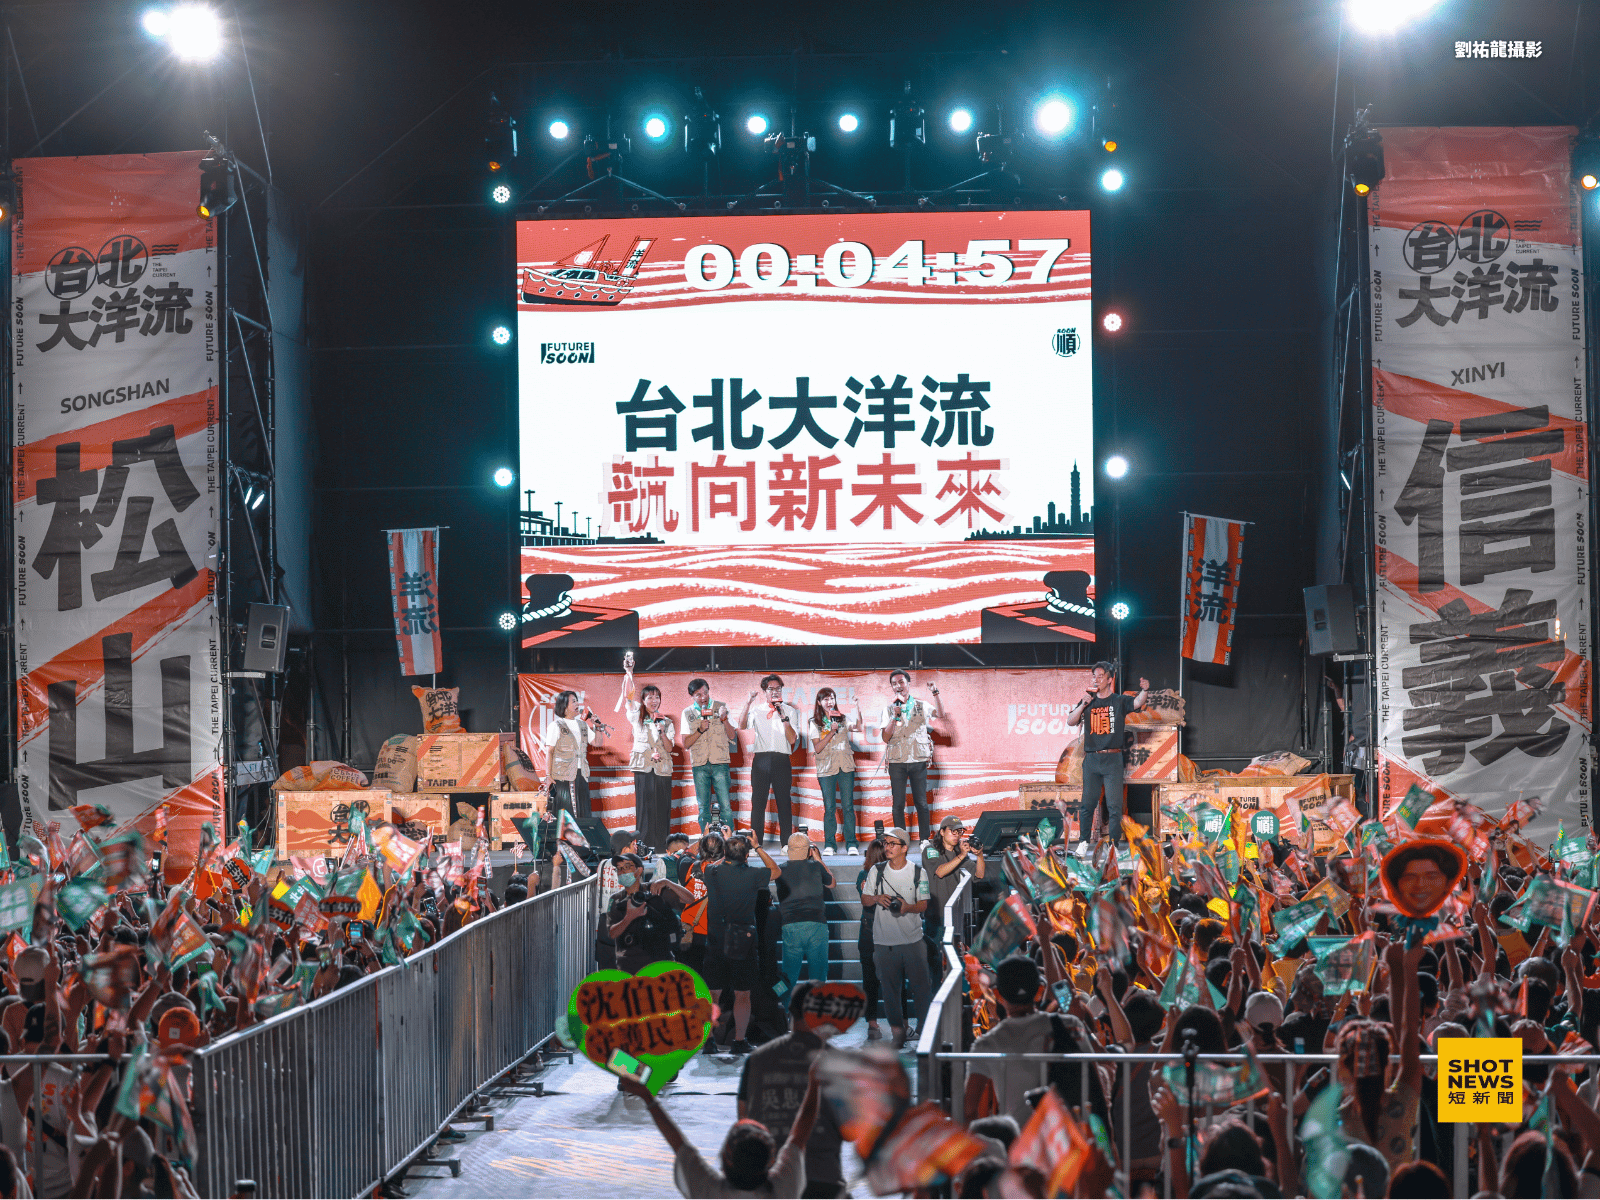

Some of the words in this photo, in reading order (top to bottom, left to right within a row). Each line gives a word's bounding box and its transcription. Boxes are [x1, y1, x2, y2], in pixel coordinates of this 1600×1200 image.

[1373, 187, 1381, 211] TAIPE
[1373, 215, 1381, 232] THE
[1407, 212, 1506, 271] 台北
[49, 237, 145, 297] 台北
[684, 238, 1070, 290] 00:04:57
[1374, 270, 1382, 299] SOON
[1395, 258, 1559, 328] 大洋流
[1571, 268, 1579, 298] SOON
[16, 297, 24, 326] SOON
[36, 281, 194, 352] 大洋流
[205, 290, 213, 320] SOON
[1374, 303, 1382, 342] FUTURE
[1572, 301, 1580, 340] FUTURE
[16, 328, 24, 367] FUTURE
[206, 323, 214, 362] FUTURE
[547, 343, 589, 351] FUTURE
[1056, 334, 1076, 355] 順
[546, 353, 589, 364] SOON
[1451, 361, 1505, 387] XINYI
[60, 378, 170, 414] SONGSHAN
[1377, 380, 1385, 425] CURRENT
[1574, 377, 1582, 422] CURRENT
[17, 403, 25, 447] CURRENT
[206, 400, 215, 445] CURRENT
[616, 373, 994, 452] 台北大洋流
[1575, 425, 1583, 452] TAIPEI
[207, 447, 215, 472] TAIPEI
[1378, 459, 1386, 477] THE
[1576, 457, 1584, 474] THE
[18, 481, 26, 499] THE
[1378, 515, 1387, 546] SOON
[1576, 513, 1585, 543] SOON
[18, 535, 26, 565] SOON
[1379, 549, 1387, 588] FUTURE
[1577, 546, 1585, 585] FUTURE
[18, 568, 27, 606] FUTURE
[207, 569, 215, 602] FUTUR
[1193, 557, 1232, 625] 洋流
[1394, 404, 1570, 776] 信義
[32, 424, 201, 811] 松山
[209, 639, 218, 684] CURRENT
[1381, 625, 1389, 670] CURRENT
[782, 687, 857, 705] TAIEI
[1580, 672, 1588, 700] TAIPEI
[1018, 704, 1077, 716] FUTUR
[1090, 713, 1110, 735] 順
[1580, 703, 1588, 721] THE
[22, 721, 30, 737] THE
[211, 717, 219, 735] THE
[211, 772, 220, 801] SOON
[1382, 761, 1391, 790] SOON
[1579, 757, 1588, 787] SOON
[23, 774, 31, 803] SOON
[1303, 795, 1323, 803] FUTUR
[24, 807, 32, 835] UTURE
[212, 805, 220, 837] UTURE
[1580, 790, 1589, 828] FUTURE
